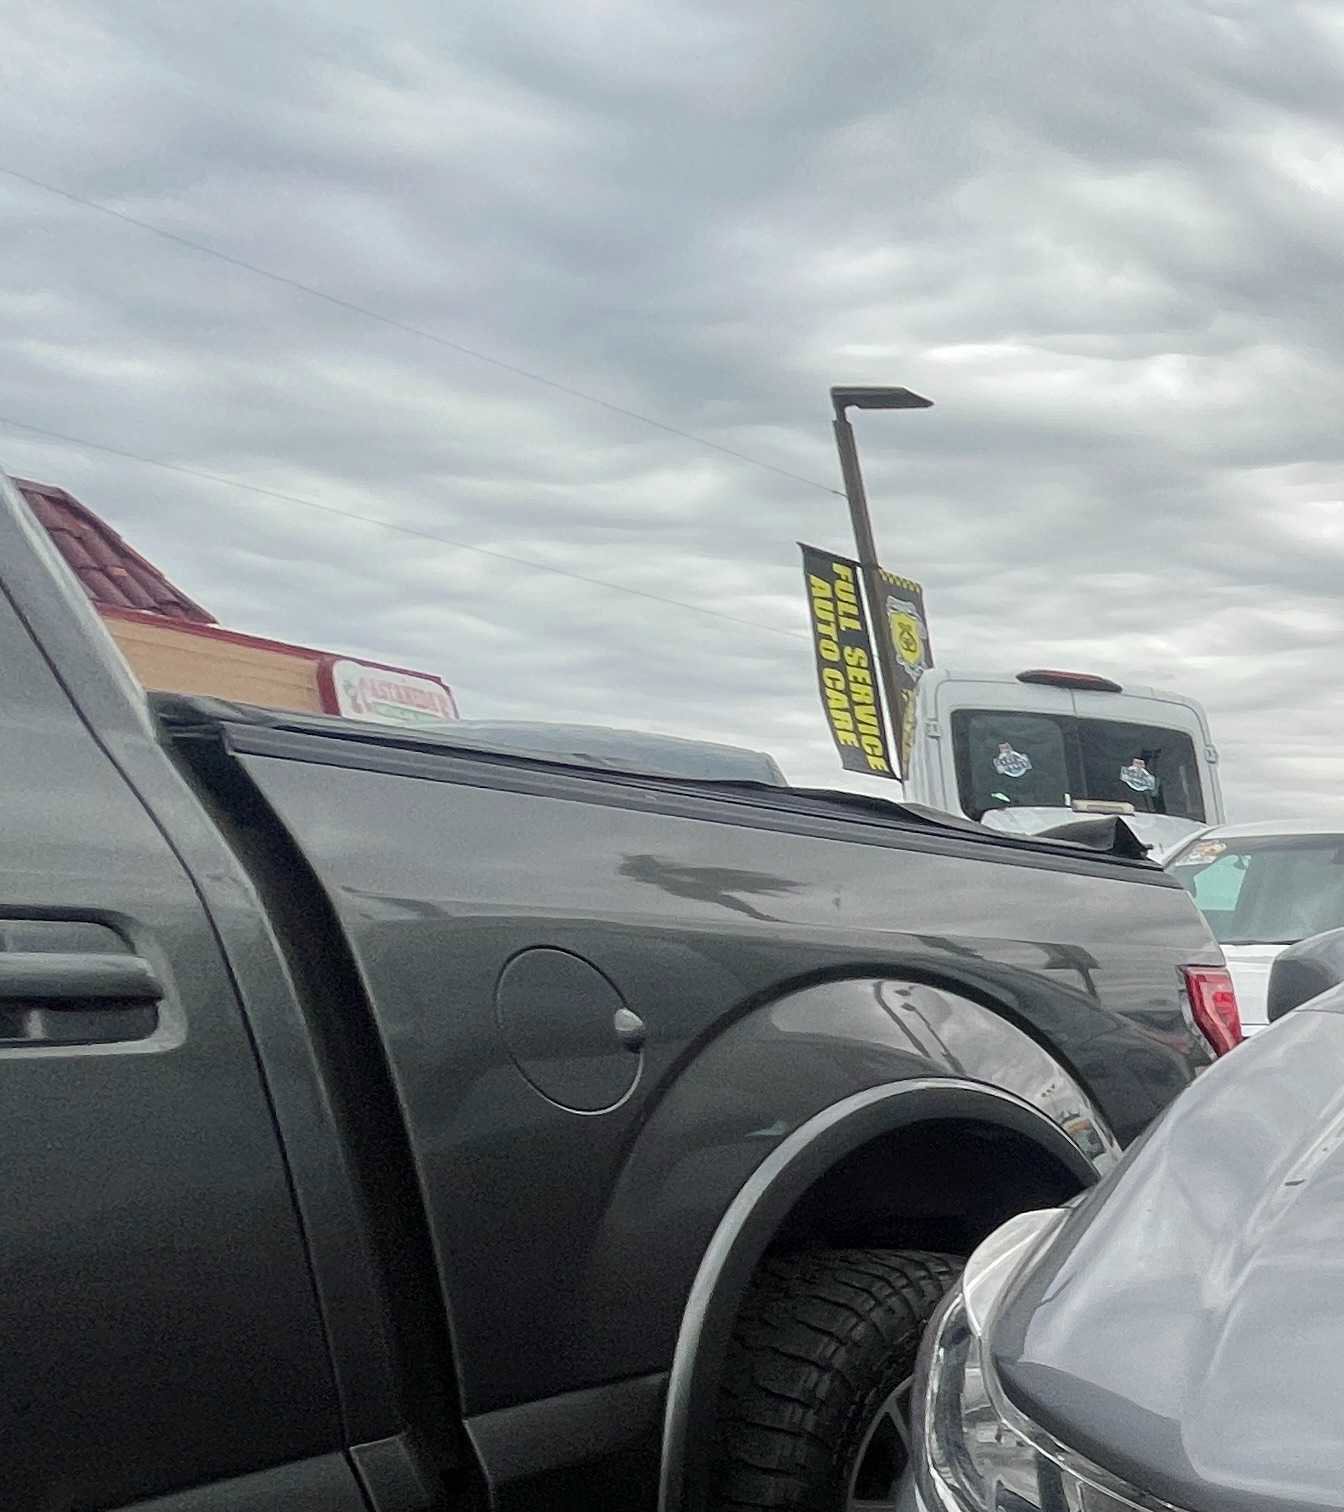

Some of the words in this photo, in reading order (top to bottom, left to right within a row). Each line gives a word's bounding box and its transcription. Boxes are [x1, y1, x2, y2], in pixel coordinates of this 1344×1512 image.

[809, 574, 841, 662] AUTO
[832, 562, 862, 632] FULL
[822, 667, 860, 748] CARE
[843, 646, 890, 772] SERVICE
